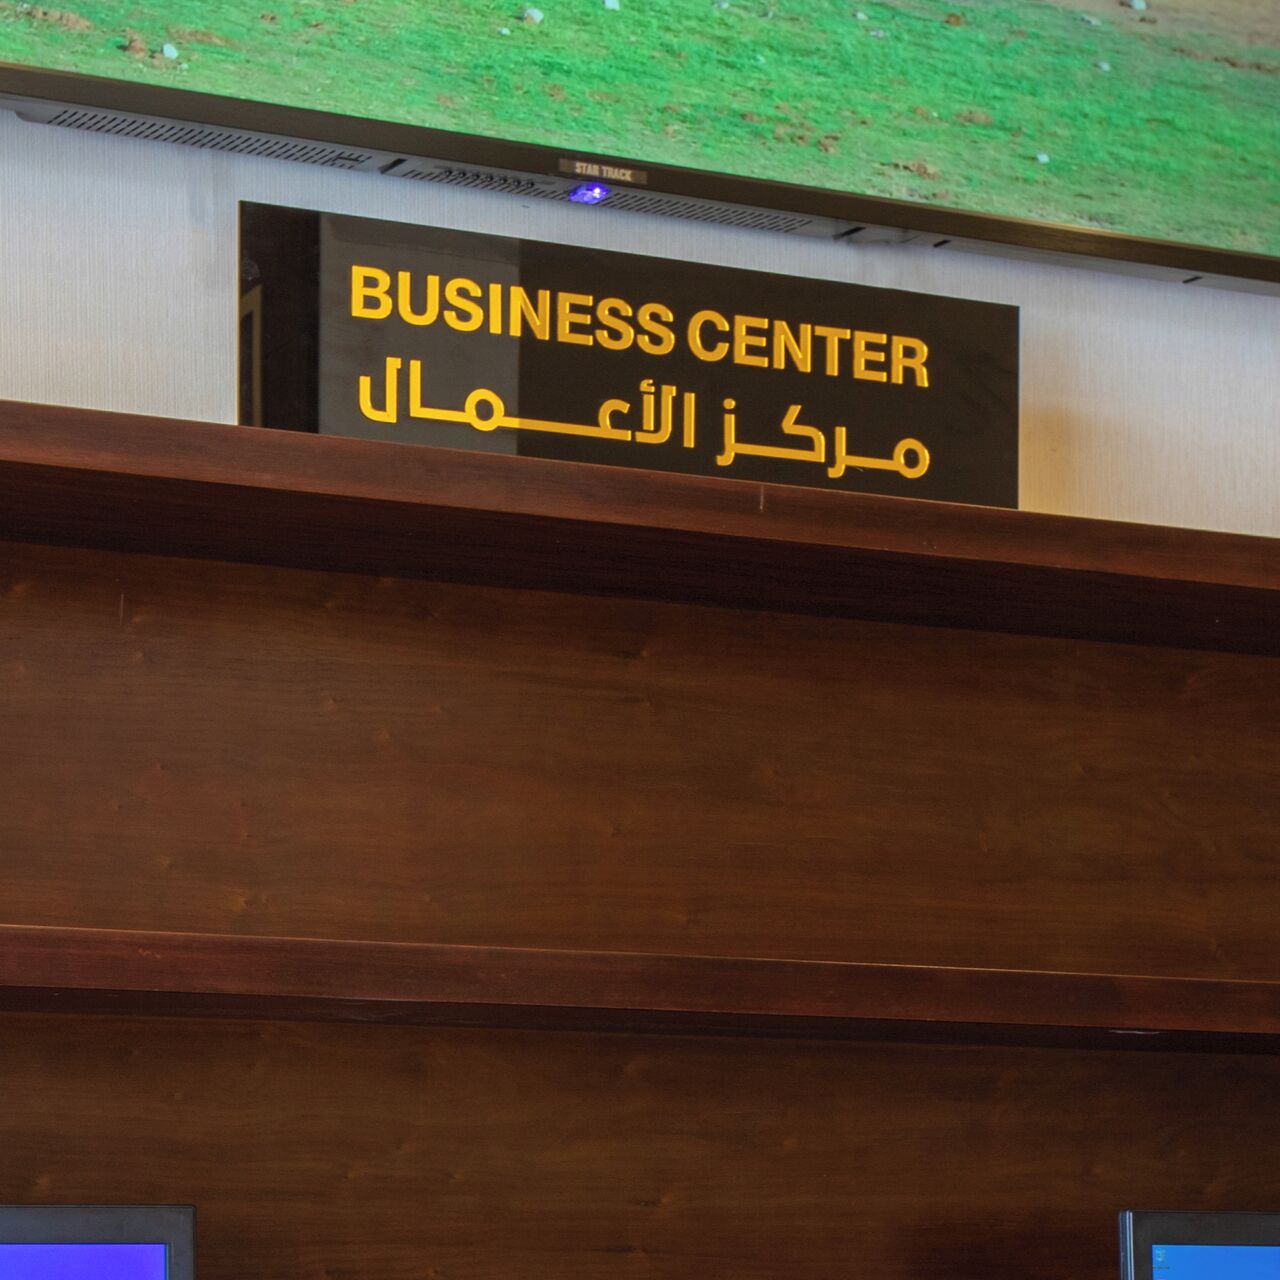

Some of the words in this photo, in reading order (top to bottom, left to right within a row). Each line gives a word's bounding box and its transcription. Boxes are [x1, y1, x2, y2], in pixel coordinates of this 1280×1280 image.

[575, 162, 600, 176] STAR
[602, 166, 633, 181] TRACK
[350, 264, 677, 356] BUSINESS
[687, 310, 930, 388] CENTER
[358, 356, 696, 449] الأعمال
[716, 398, 931, 479] مركز
